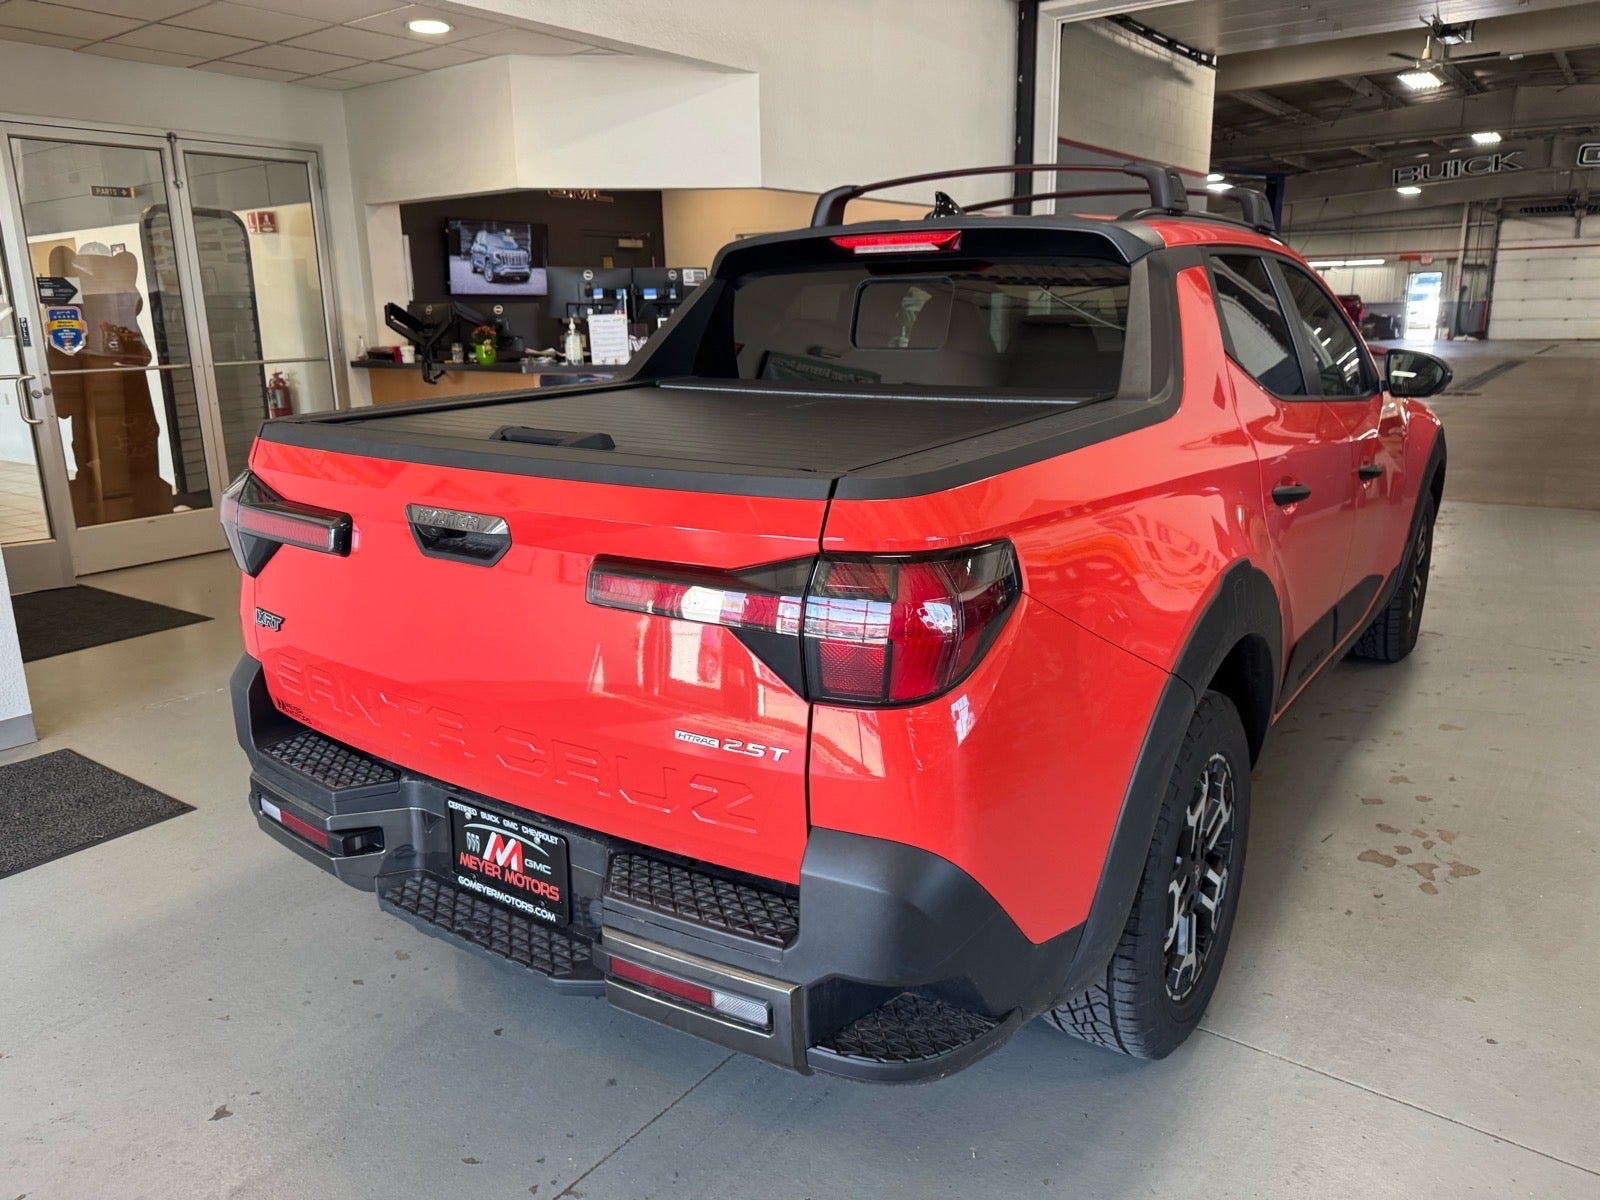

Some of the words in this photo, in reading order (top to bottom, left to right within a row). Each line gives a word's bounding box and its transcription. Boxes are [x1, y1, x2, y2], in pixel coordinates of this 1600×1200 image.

[1392, 151, 1523, 186] BUICK
[95, 187, 118, 196] PARTS
[256, 608, 283, 632] XRT
[275, 651, 478, 760] SANTA
[676, 731, 717, 746] HTRAC
[495, 725, 759, 835] CRUZ
[502, 819, 519, 831] GMC
[521, 826, 559, 845] CHEVROLET
[460, 852, 502, 880] MEYER
[504, 870, 560, 902] MOTORS
[524, 859, 552, 875] GMC
[457, 876, 556, 922] GOMEYERMOTORS.COM
